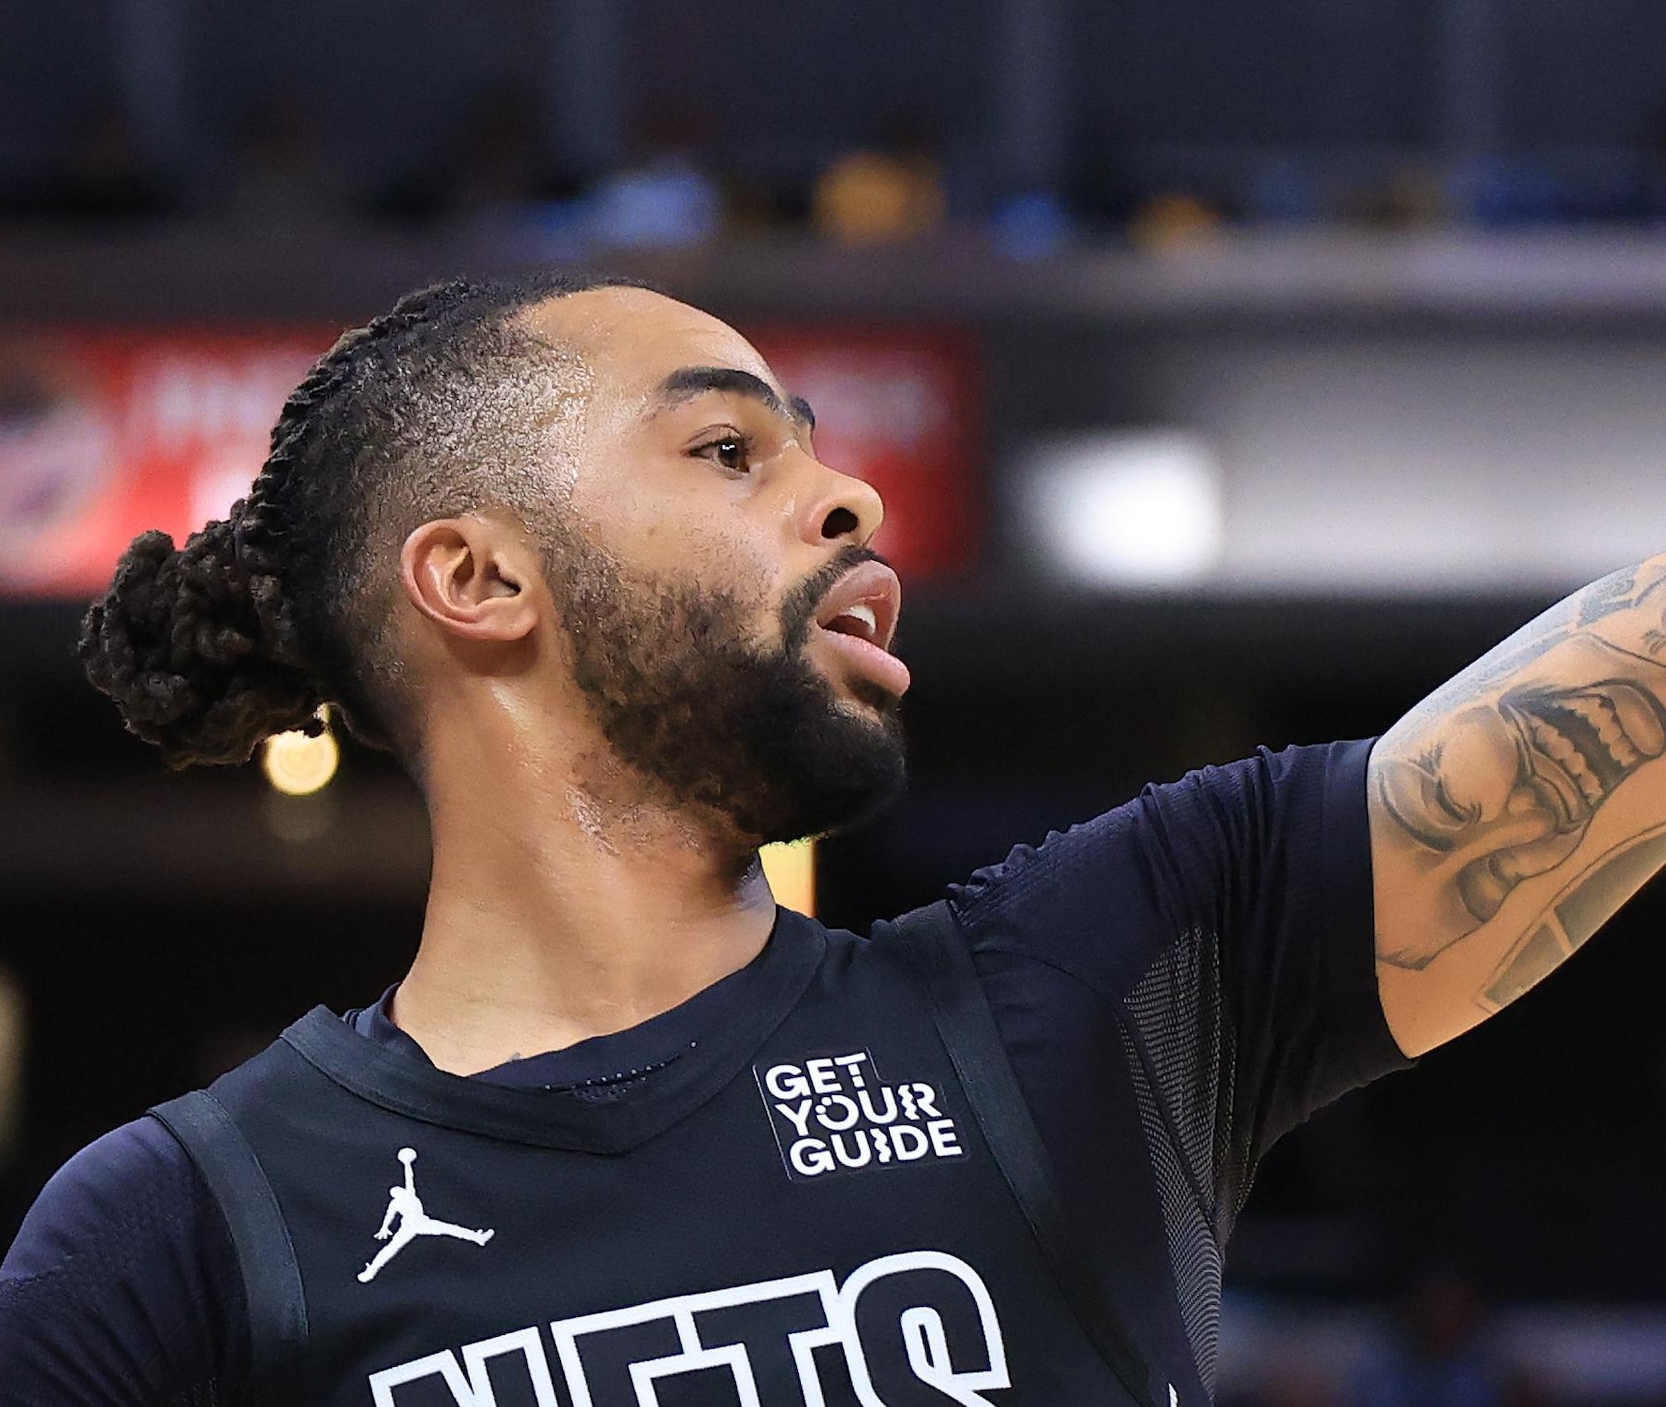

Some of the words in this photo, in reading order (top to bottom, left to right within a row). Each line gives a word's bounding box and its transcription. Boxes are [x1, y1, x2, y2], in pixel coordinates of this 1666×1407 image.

[765, 1052, 867, 1100] GET
[775, 1083, 942, 1137] YOUR
[789, 1119, 963, 1176] GUIDE
